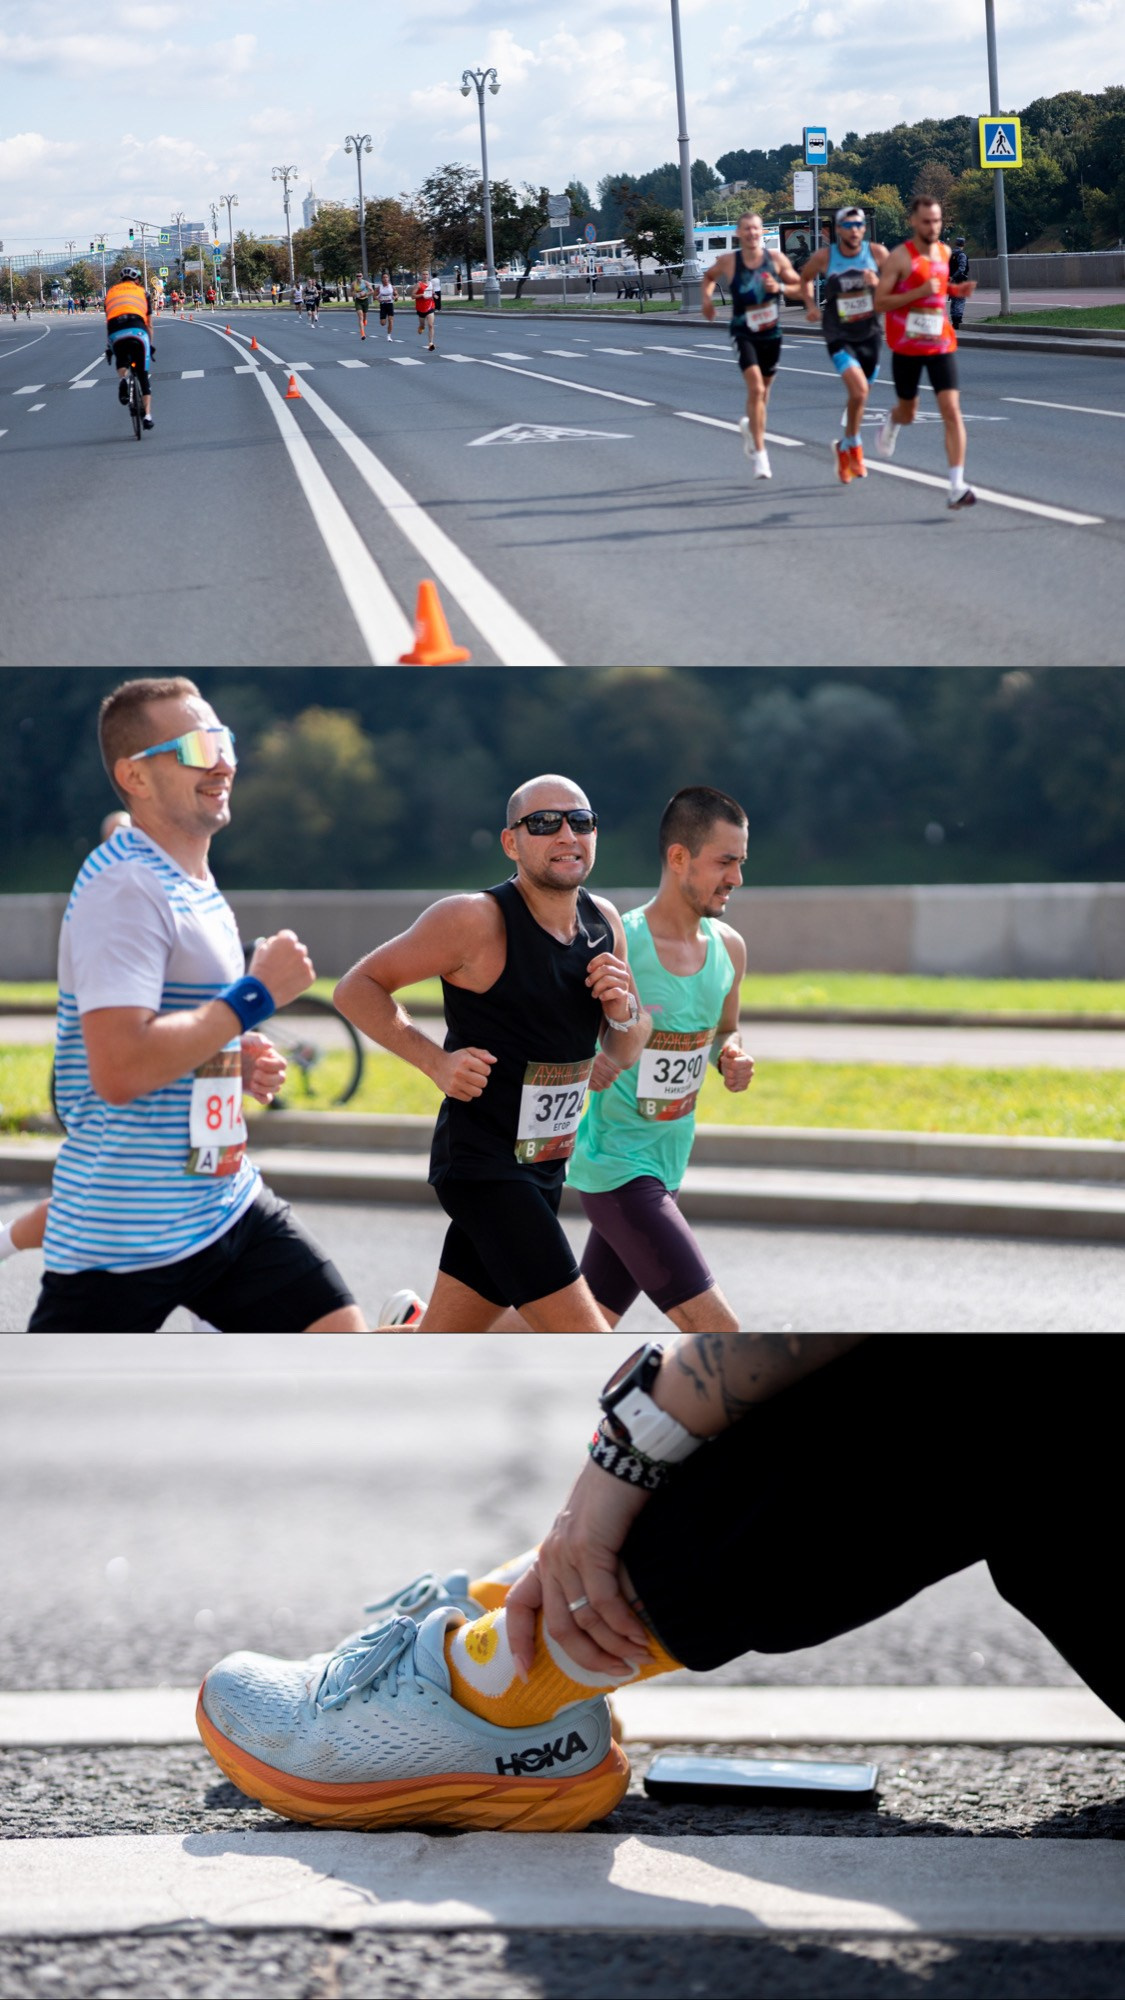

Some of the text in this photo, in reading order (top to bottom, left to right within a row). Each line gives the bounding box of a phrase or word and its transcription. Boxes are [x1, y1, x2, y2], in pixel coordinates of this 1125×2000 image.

[553, 1121, 571, 1132] ЕГОР
[200, 1151, 213, 1170] A
[495, 1730, 589, 1776] HOKA
